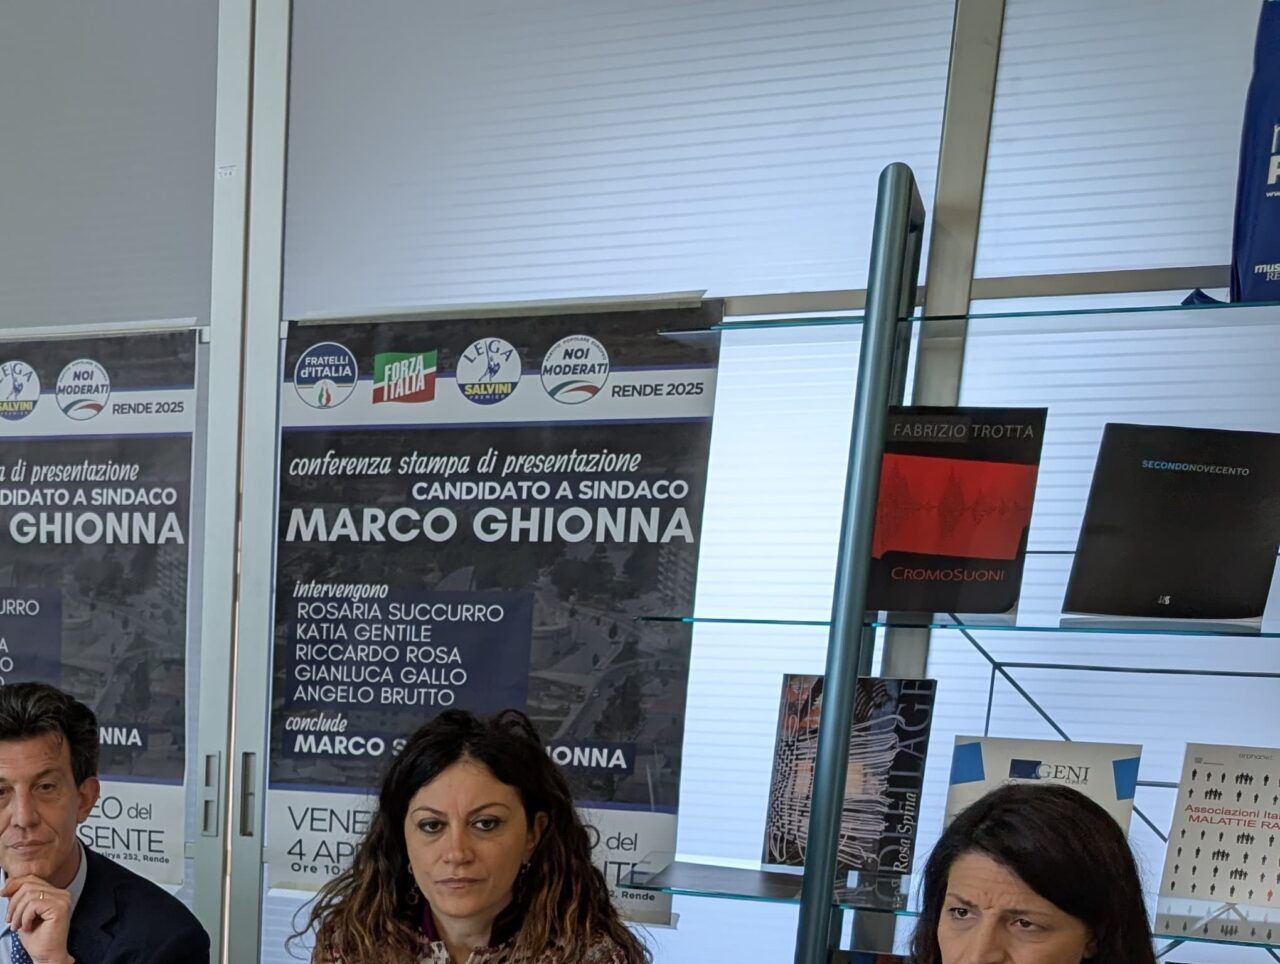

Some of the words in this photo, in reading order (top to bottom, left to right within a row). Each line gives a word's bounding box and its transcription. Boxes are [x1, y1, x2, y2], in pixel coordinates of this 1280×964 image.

[305, 356, 349, 365] FRATELLI
[463, 340, 513, 363] LEGA
[563, 348, 589, 359] NOI
[73, 370, 94, 381] NOI
[300, 366, 352, 378] d'ITALIA
[385, 355, 424, 380] FORZA
[543, 363, 607, 375] MODERATI
[57, 384, 109, 396] MODERATI
[384, 375, 425, 401] ITALIA
[464, 383, 512, 395] SALVINI
[611, 384, 663, 398] RENDE
[666, 383, 703, 396] 2025
[112, 402, 153, 416] RENDE
[155, 401, 185, 414] 2025
[893, 424, 966, 438] FABRIZIO
[972, 424, 1033, 439] TROTTA
[11, 459, 27, 482] di
[31, 460, 139, 485] presentazione
[289, 450, 391, 476] conferenza
[398, 451, 470, 478] stampa
[477, 449, 496, 474] di
[502, 449, 641, 477] presentazione
[1142, 459, 1249, 477] SECONDONOVECENTO
[72, 489, 87, 506] A
[91, 488, 177, 506] SINDACO
[412, 481, 550, 501] CANDIDATO
[555, 481, 572, 500] A
[579, 480, 688, 500] SINDACO
[9, 511, 185, 545] GHIONNA
[285, 507, 457, 542] MARCO
[473, 506, 695, 544] GHIONNA
[293, 580, 388, 601] intervengono
[297, 603, 381, 620] ROSARIA
[388, 604, 504, 622] SUCCURRO
[296, 623, 347, 641] KATIA
[353, 625, 432, 643] GENTILE
[295, 644, 399, 662] RICCARDO
[407, 646, 462, 664] ROSA
[295, 664, 393, 683] GIANLUCA
[400, 667, 467, 686] GALLO
[293, 685, 374, 703] ANGELO
[381, 686, 454, 706] BRUTTO
[285, 713, 347, 733] conclude
[294, 735, 384, 756] MARCO
[546, 745, 627, 769] ONNA
[127, 802, 152, 820] del
[898, 792, 918, 835] Spina
[1184, 804, 1260, 818] Associazioni
[1188, 815, 1257, 828] MALATTIE
[287, 839, 306, 861] 4
[606, 832, 638, 851] del
[143, 855, 170, 864] Rende
[893, 837, 912, 873] Rosa
[291, 862, 318, 874] Ore
[621, 891, 656, 901] Rende
